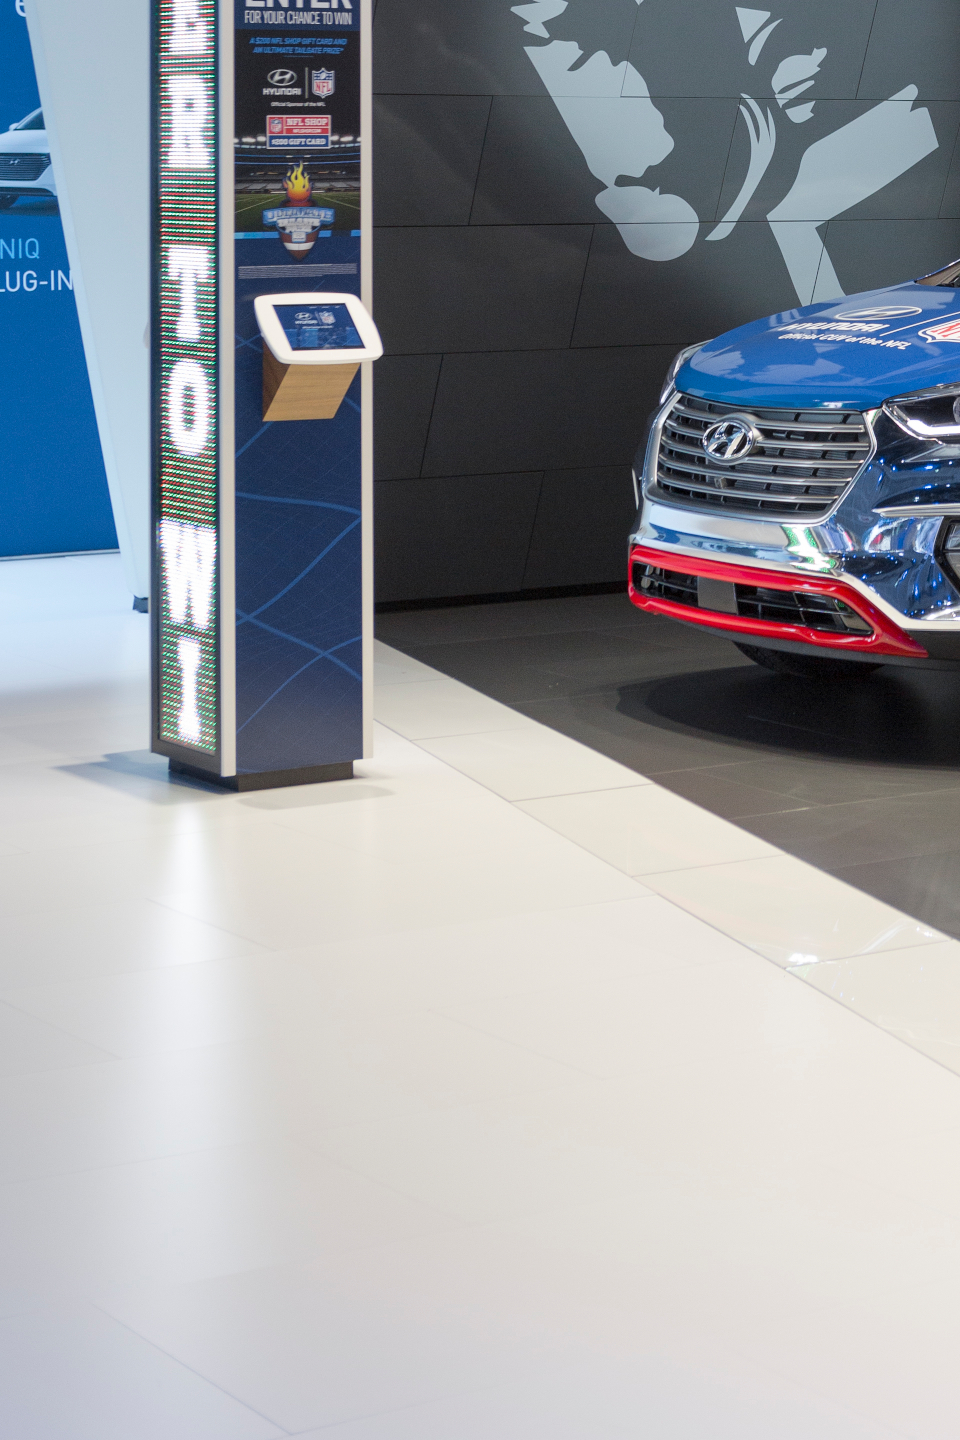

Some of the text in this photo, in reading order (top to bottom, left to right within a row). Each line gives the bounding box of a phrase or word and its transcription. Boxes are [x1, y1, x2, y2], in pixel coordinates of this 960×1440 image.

[244, 10, 353, 25] FOR YOUR CHANCE TO WIN
[262, 88, 302, 96] HYUNDAI
[315, 81, 332, 93] NFL
[286, 118, 328, 126] NFL SHOP
[777, 322, 890, 332] HYUNDAI
[778, 332, 818, 341] Official
[859, 336, 878, 346] the
[879, 340, 912, 350] NFL
